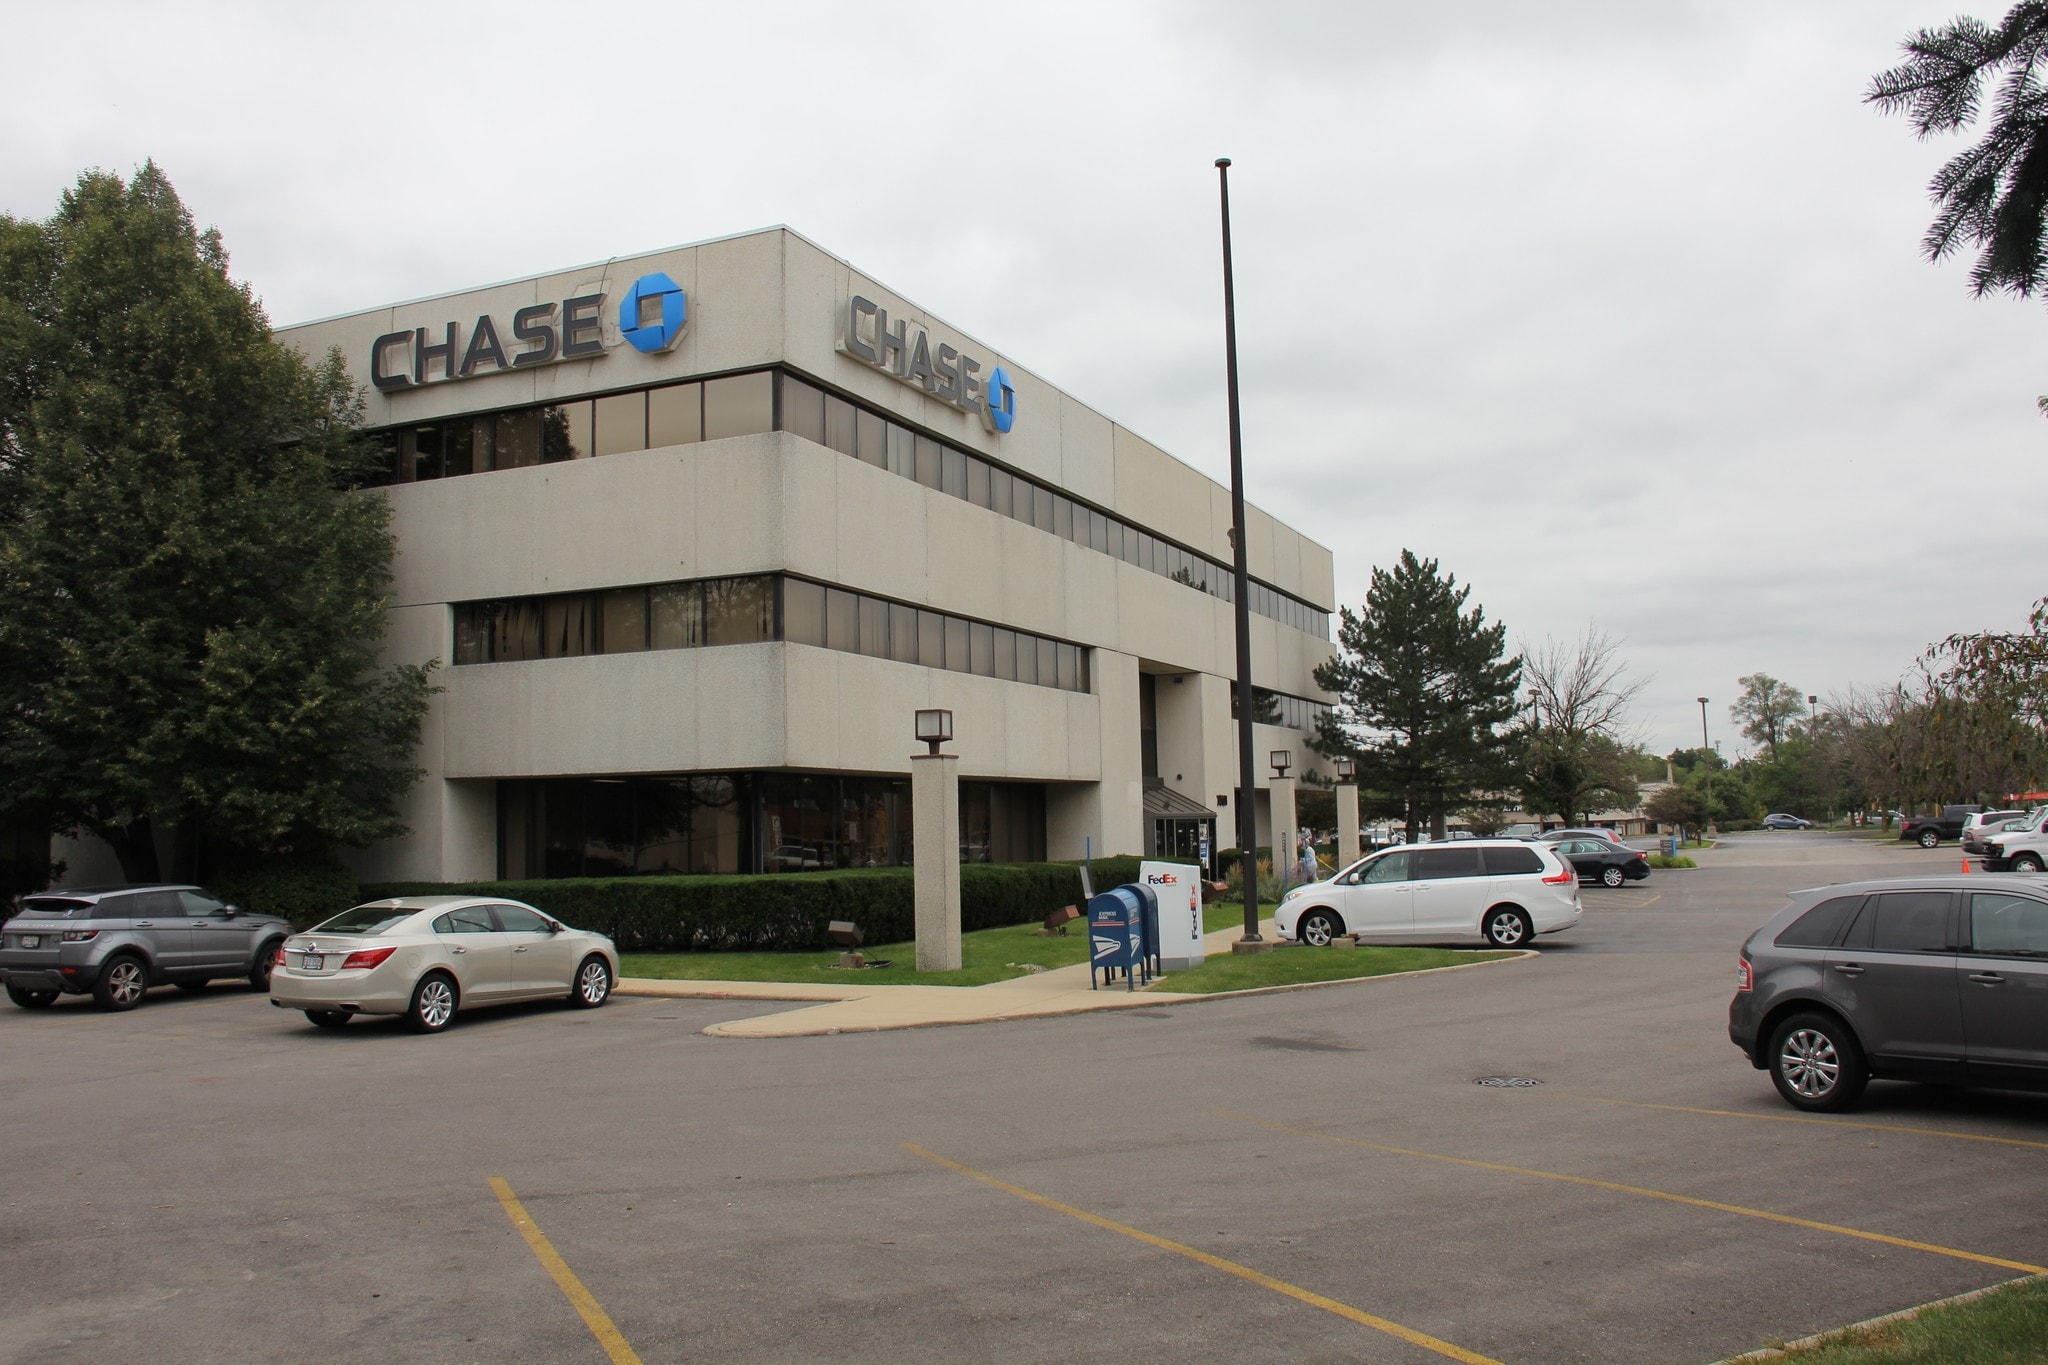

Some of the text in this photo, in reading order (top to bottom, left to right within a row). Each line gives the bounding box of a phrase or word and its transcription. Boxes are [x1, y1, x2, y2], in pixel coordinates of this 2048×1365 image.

[371, 293, 607, 391] CHASE
[847, 295, 981, 414] CHASE
[1148, 873, 1177, 885] FedEx
[1190, 884, 1198, 940] FedEx
